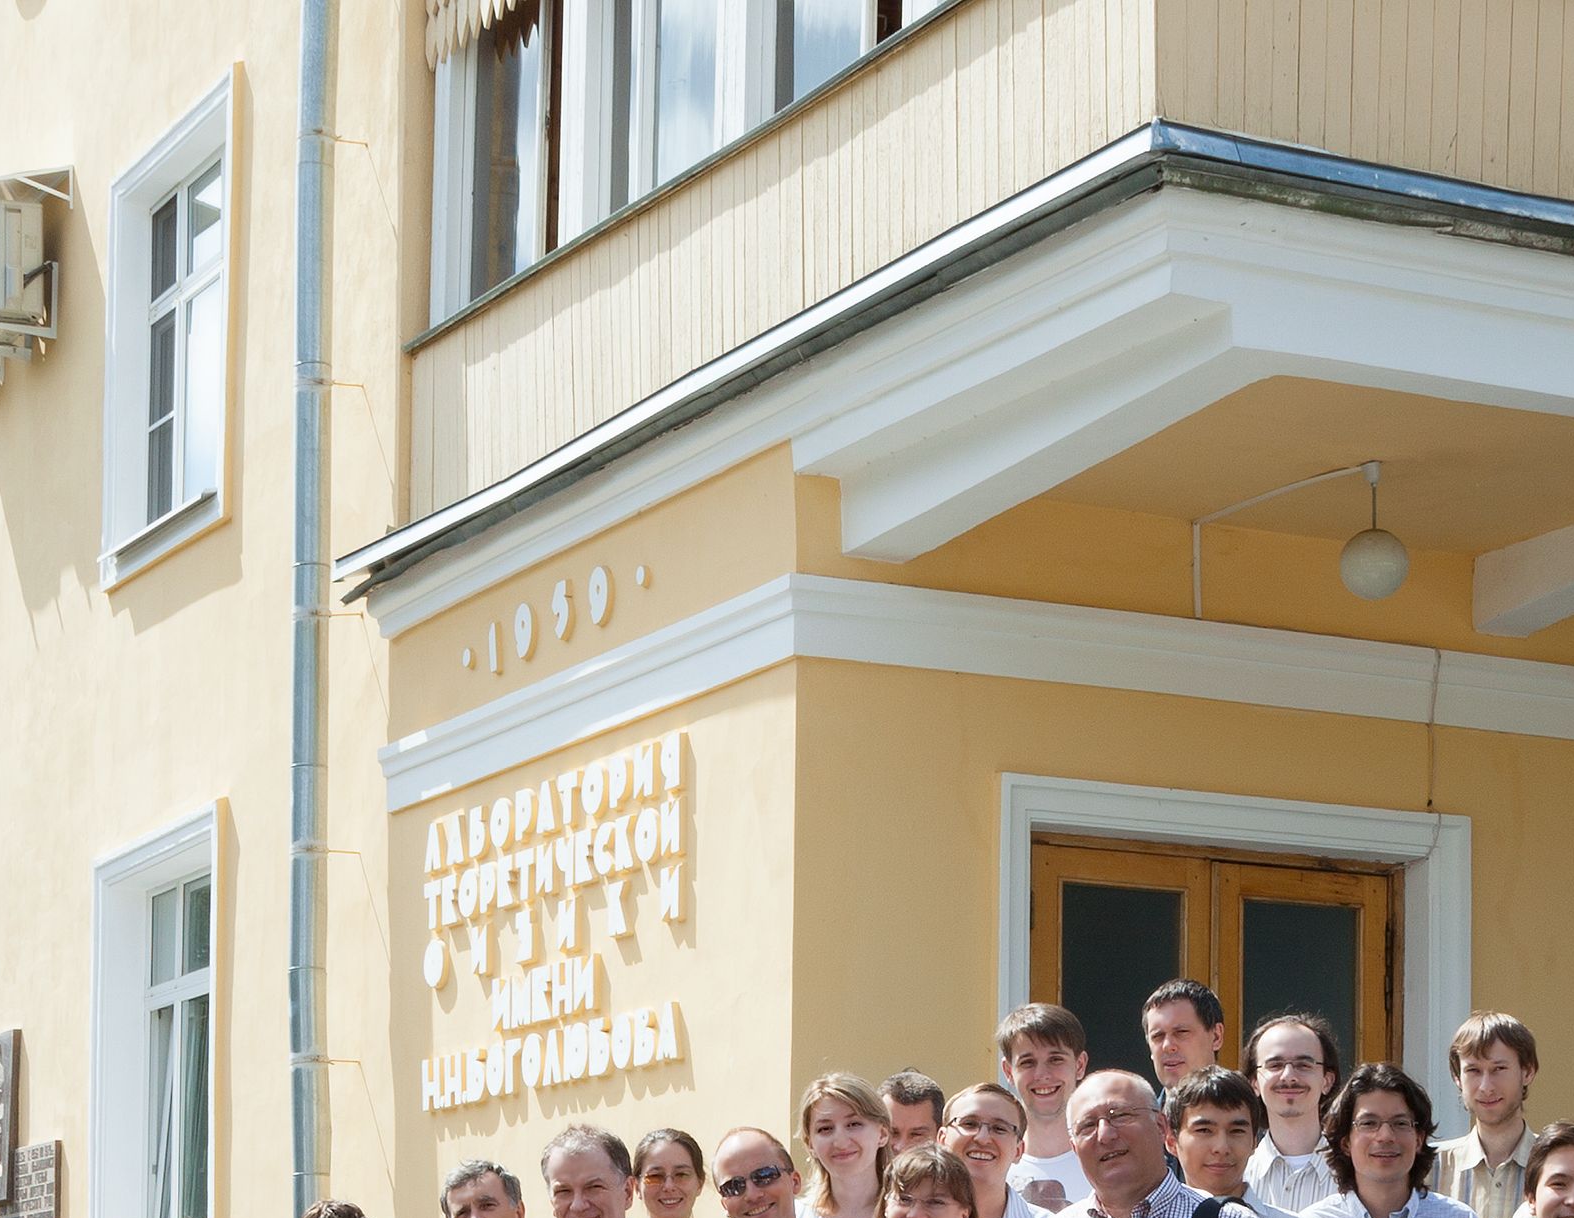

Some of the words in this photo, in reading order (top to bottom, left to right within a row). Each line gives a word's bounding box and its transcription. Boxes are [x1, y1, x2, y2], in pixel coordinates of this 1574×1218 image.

[424, 731, 686, 873] ЛАБОРАТОРИЯ
[424, 797, 685, 930] ТЕОРЕТИЧЕСКОЙ
[492, 953, 600, 1031] ИМЕНИ
